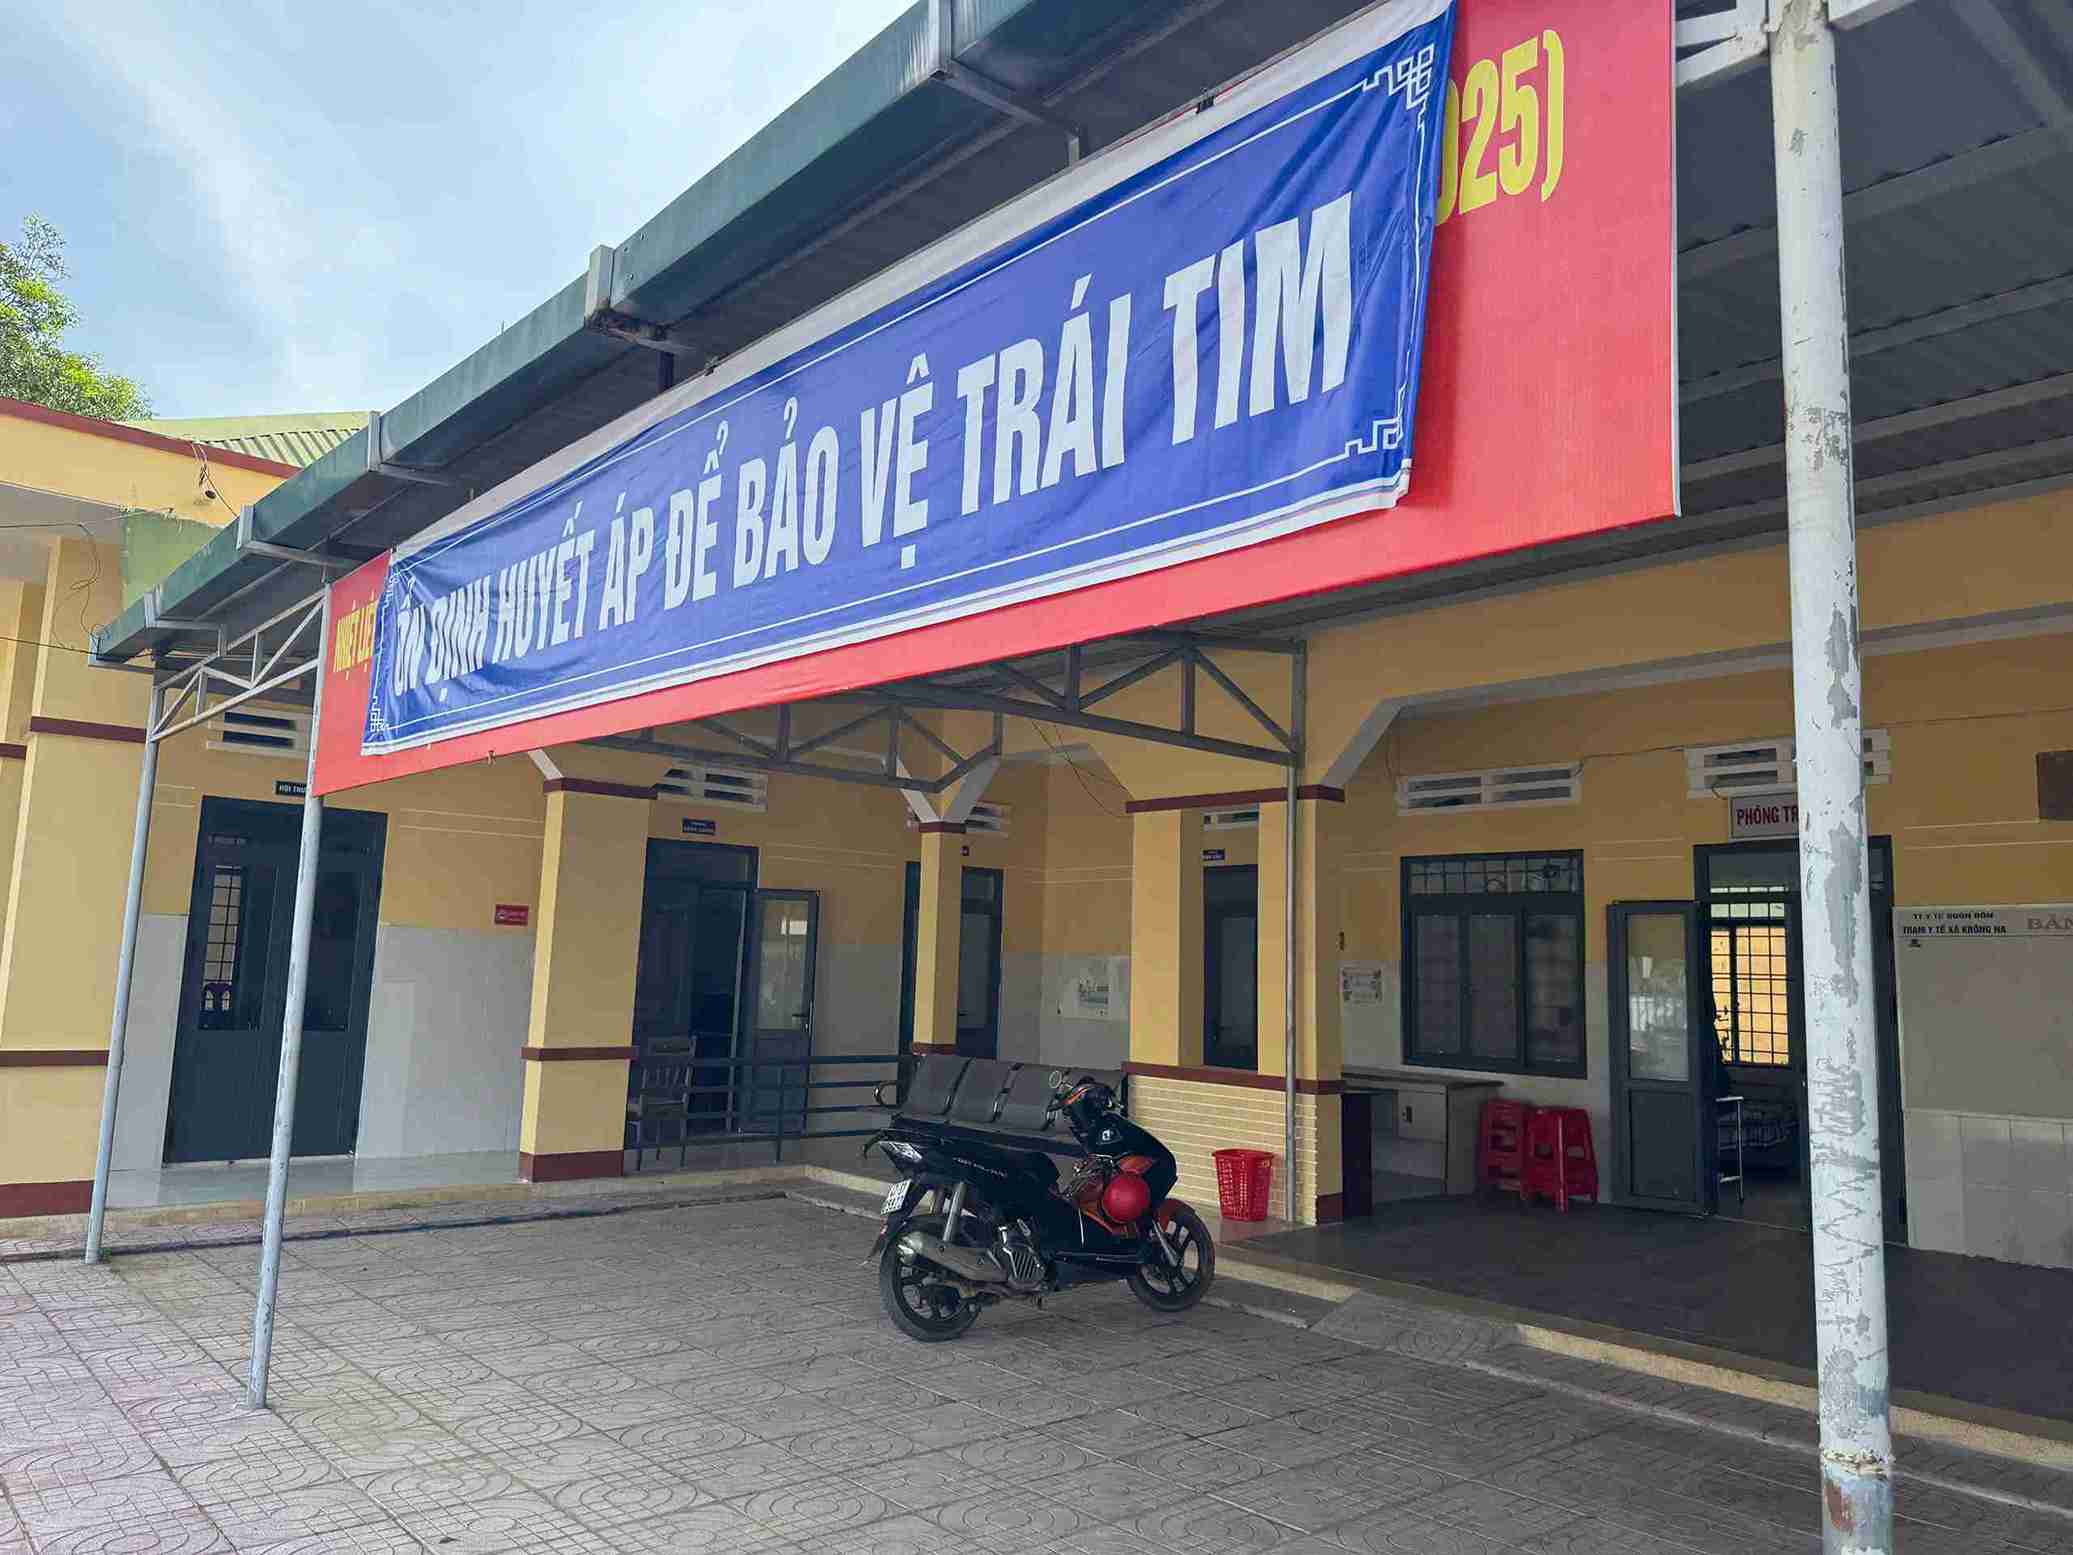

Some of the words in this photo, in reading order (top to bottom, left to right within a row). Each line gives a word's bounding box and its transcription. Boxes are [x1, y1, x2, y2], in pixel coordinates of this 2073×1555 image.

[393, 575, 424, 696] ỔN
[425, 575, 490, 702] ĐỊNH
[492, 501, 595, 664] HUYẾT
[599, 491, 654, 631] ÁP
[664, 421, 729, 610] ĐỂ
[734, 397, 839, 589] BẢO
[861, 352, 933, 570] VỆ
[957, 273, 1132, 515] TRÁI
[1163, 191, 1352, 446] TIM
[1736, 804, 1779, 825] PHÒNG
[1936, 924, 1946, 934] TẾ
